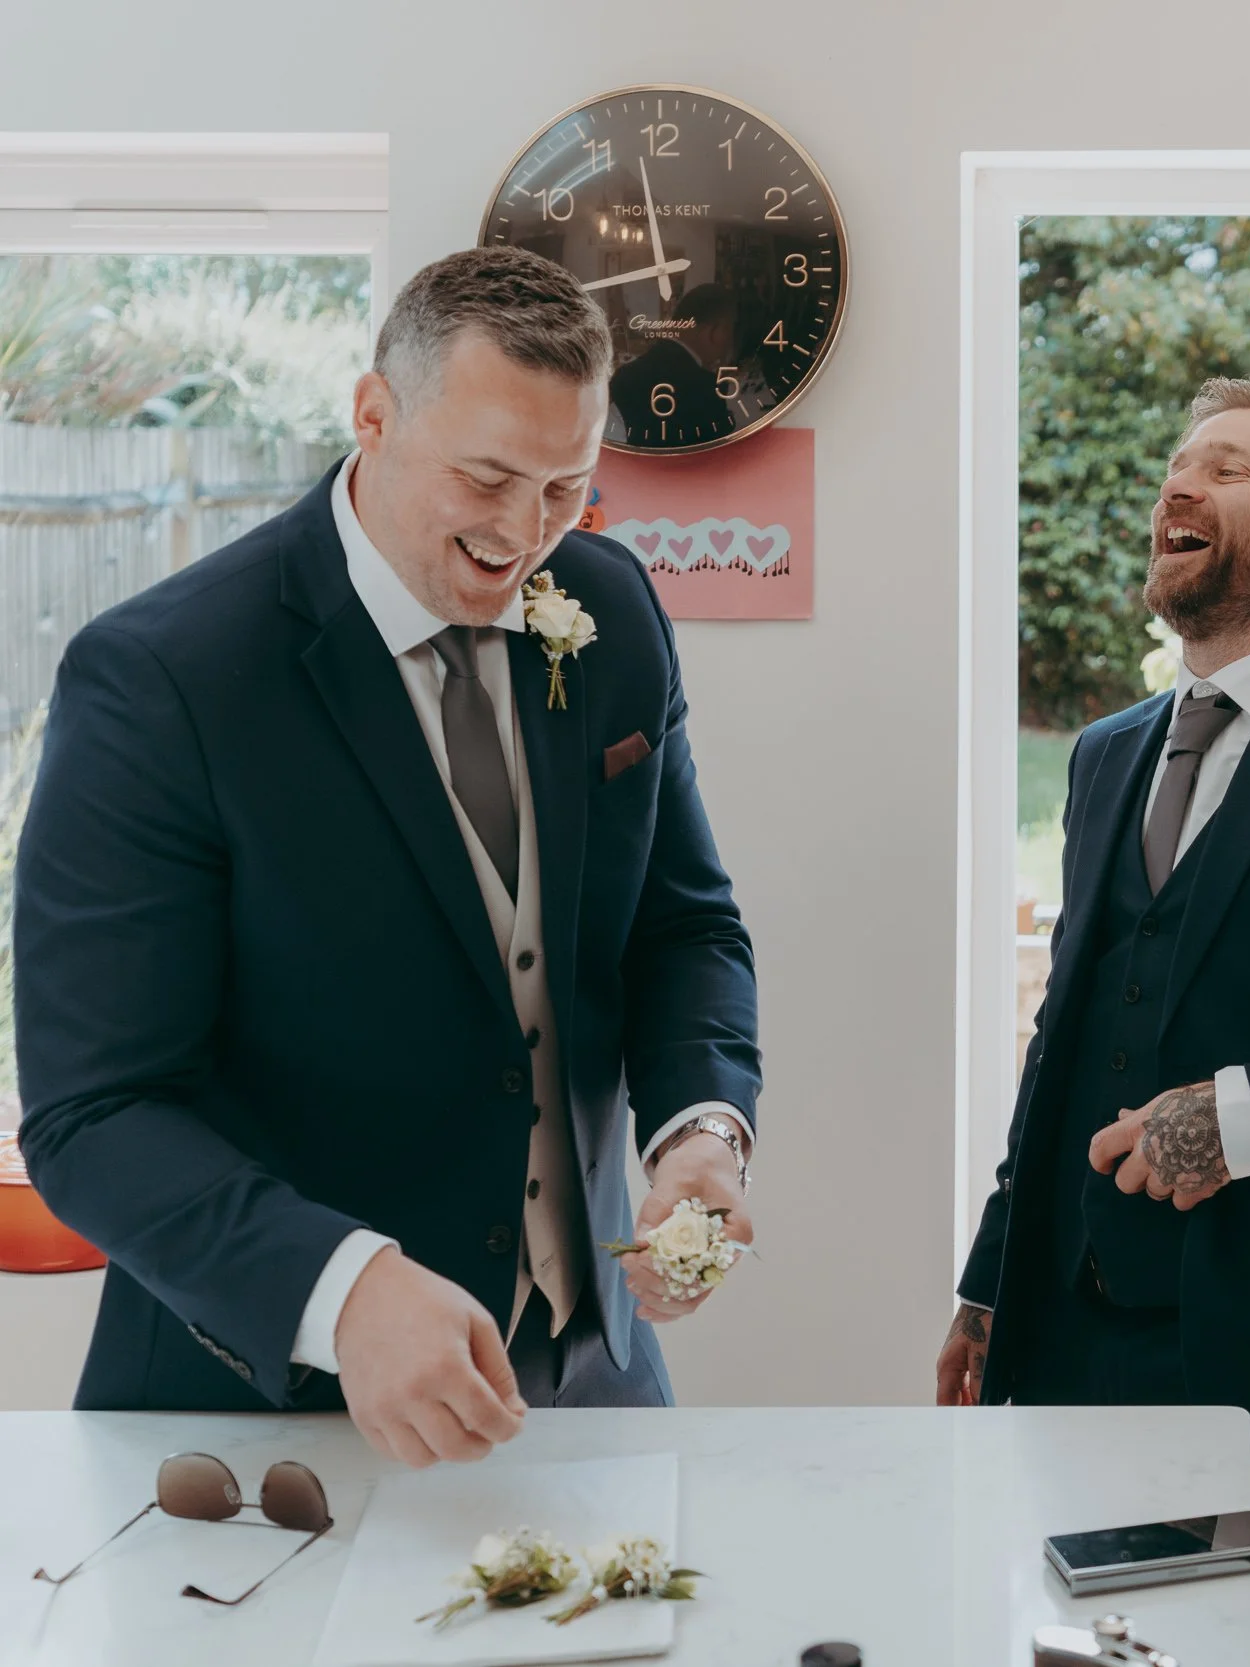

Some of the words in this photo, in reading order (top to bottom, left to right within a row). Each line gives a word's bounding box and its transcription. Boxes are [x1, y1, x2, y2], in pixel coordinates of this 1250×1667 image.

[583, 139, 612, 172] 11
[640, 124, 680, 157] 12
[718, 139, 733, 171] 1
[534, 188, 574, 221] 10
[675, 205, 711, 216] KENT
[765, 187, 789, 220] 2
[783, 254, 808, 287] 3
[629, 314, 696, 331] Greenwich
[763, 320, 788, 352] 4
[715, 367, 740, 399] 5
[651, 384, 675, 416] 6
